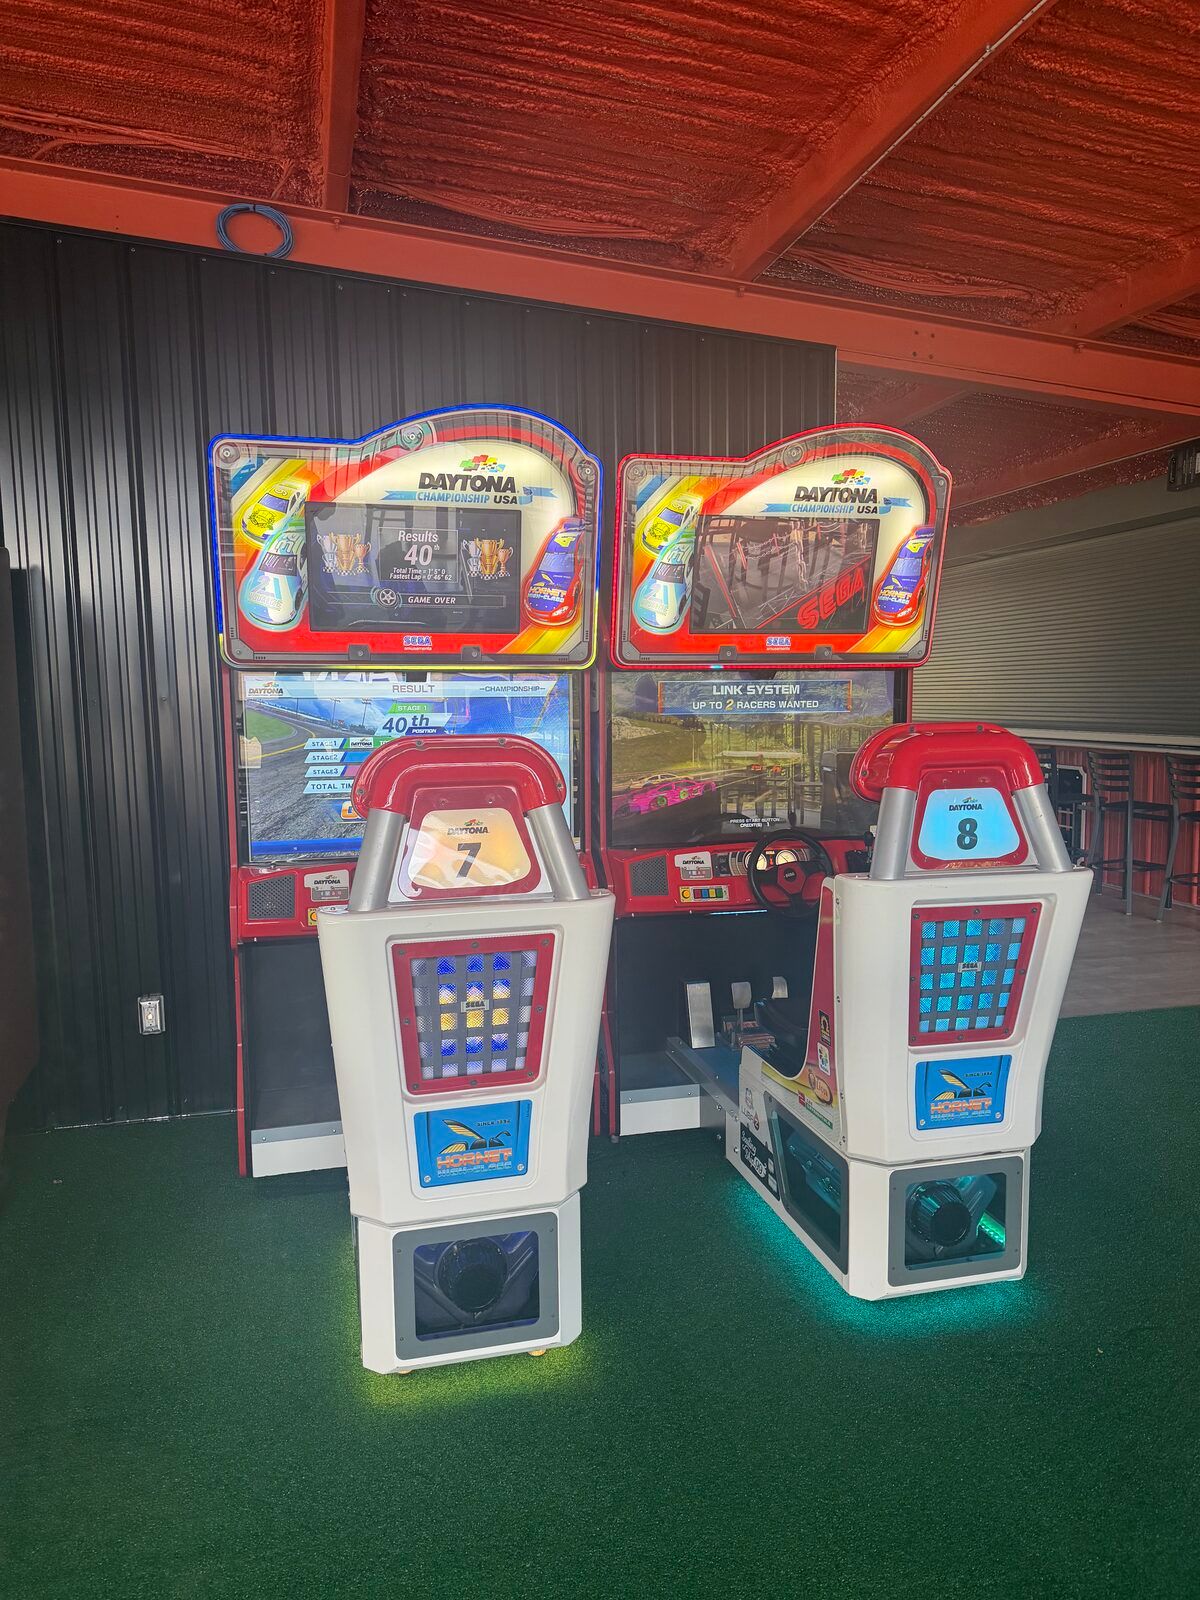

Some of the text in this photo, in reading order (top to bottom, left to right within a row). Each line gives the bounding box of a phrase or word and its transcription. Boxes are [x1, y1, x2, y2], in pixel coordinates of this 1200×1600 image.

[418, 472, 516, 493] DAYTONA
[417, 491, 518, 505] CHAMPIONSHIP USA
[794, 486, 878, 504] DAYTONA
[791, 504, 878, 514] CHAMPIONSHIP USA
[398, 530, 438, 542] Results
[408, 596, 431, 604] GAME
[797, 568, 864, 629] SEGA
[403, 635, 432, 646] SEGA
[766, 636, 791, 646] SEGA
[392, 685, 435, 693] RESULT
[712, 684, 800, 695] LINK SYSTEM
[692, 698, 819, 711] UP TO 2 RACERS WANTED
[947, 803, 983, 812] DAYTONA
[447, 826, 489, 835] DAYTONA
[956, 817, 978, 850] 8
[456, 842, 482, 878] 7
[465, 1000, 486, 1009] SEGA
[930, 1097, 993, 1115] HORNET
[436, 1147, 513, 1170] HORNET
